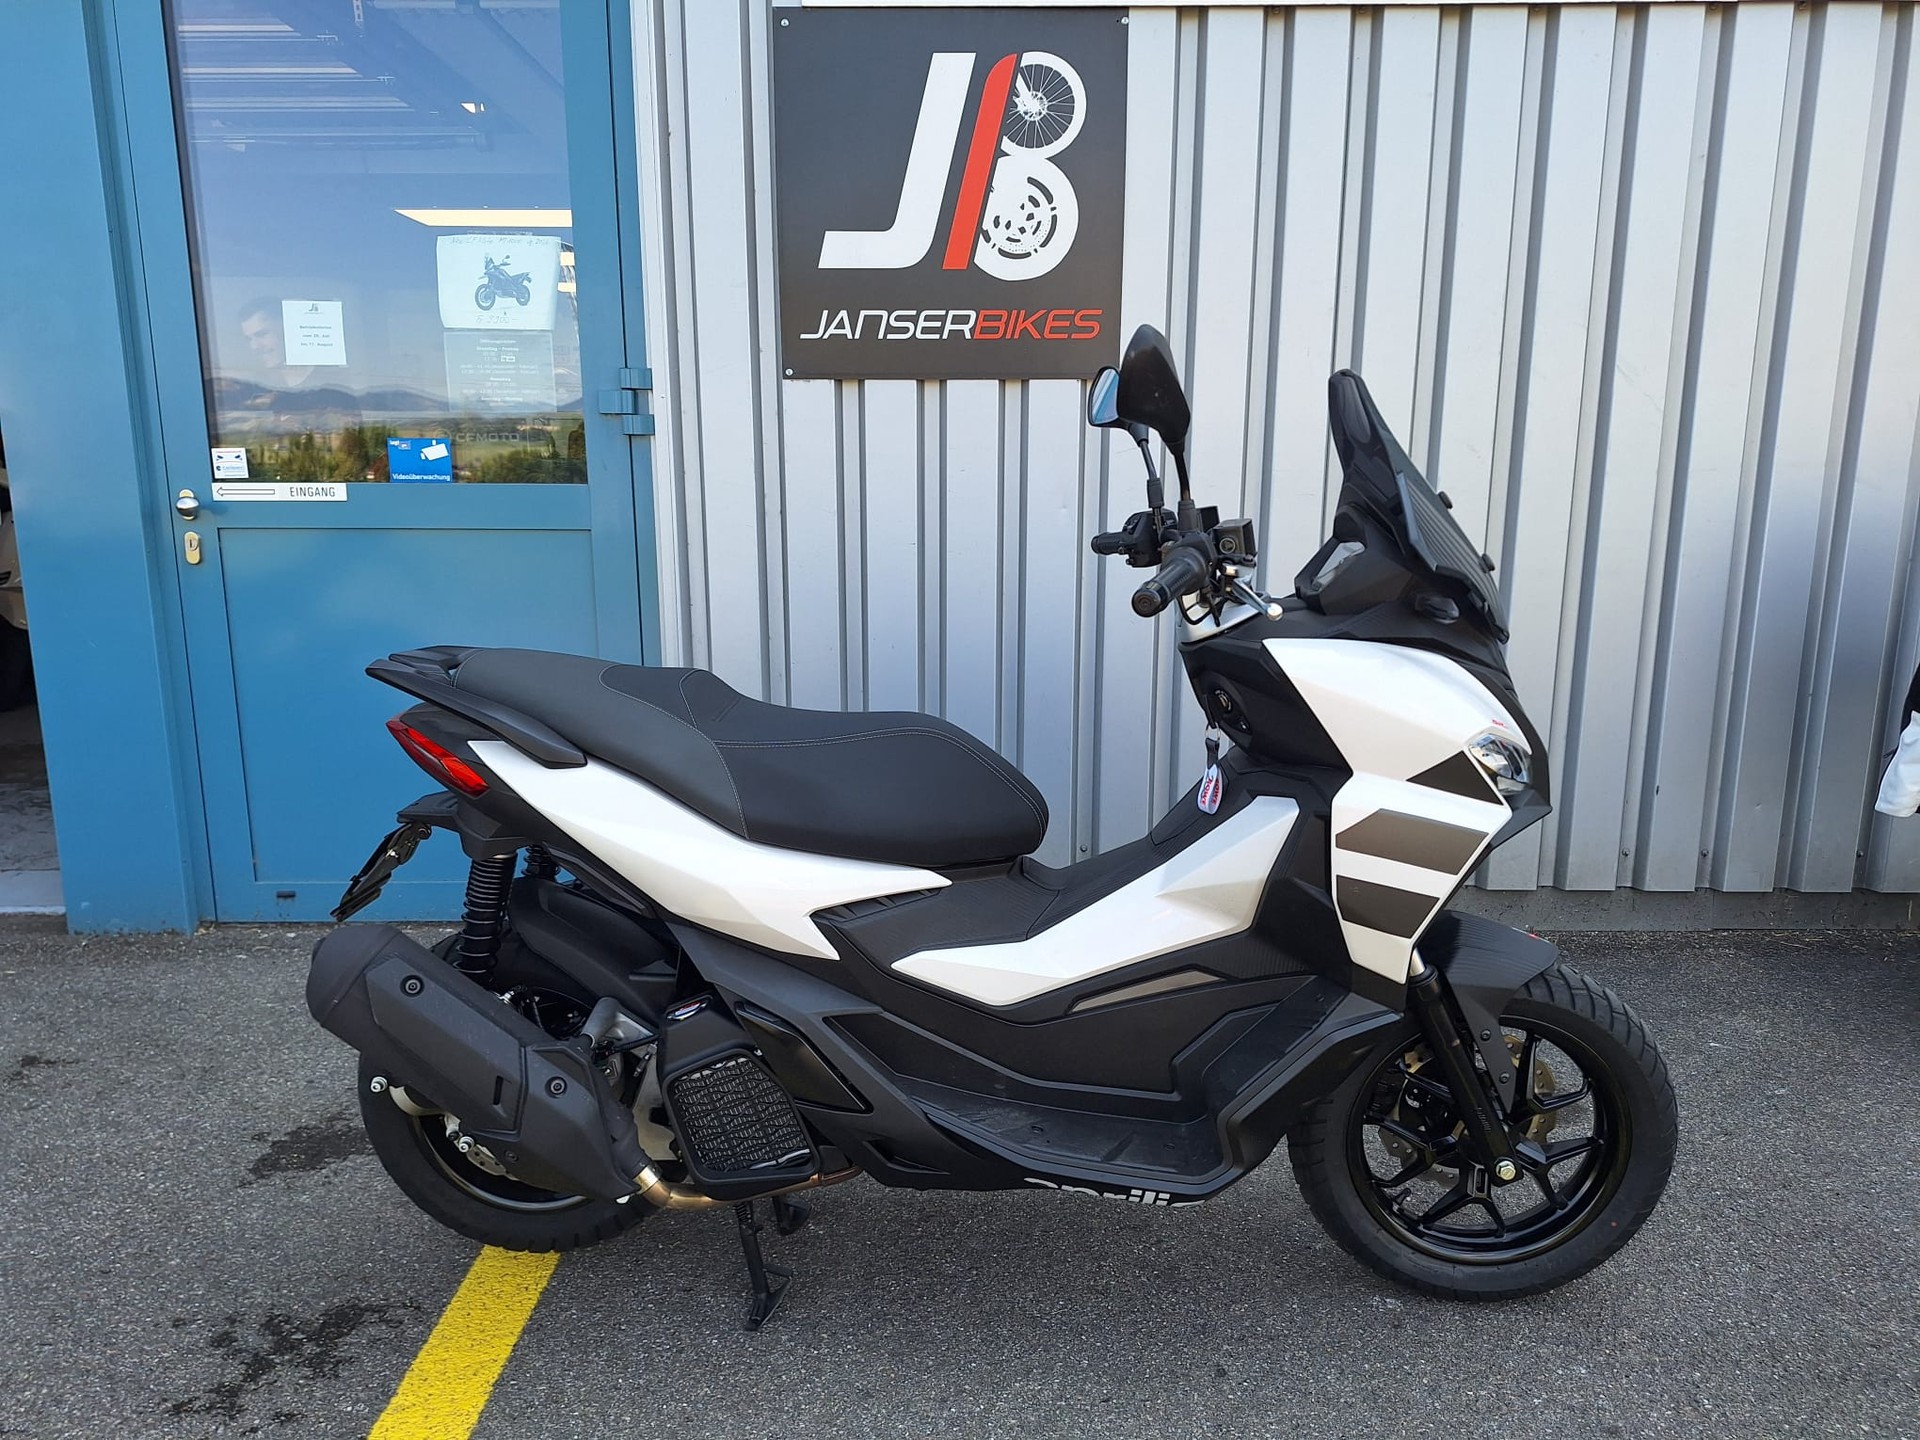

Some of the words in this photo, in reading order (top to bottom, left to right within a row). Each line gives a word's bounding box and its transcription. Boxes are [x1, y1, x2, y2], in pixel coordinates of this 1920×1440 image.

[799, 309, 1103, 340] JANSERBIKES
[456, 432, 520, 442] CFMOTO
[392, 473, 451, 482] Videoüberwachung
[289, 486, 336, 498] EINGANG
